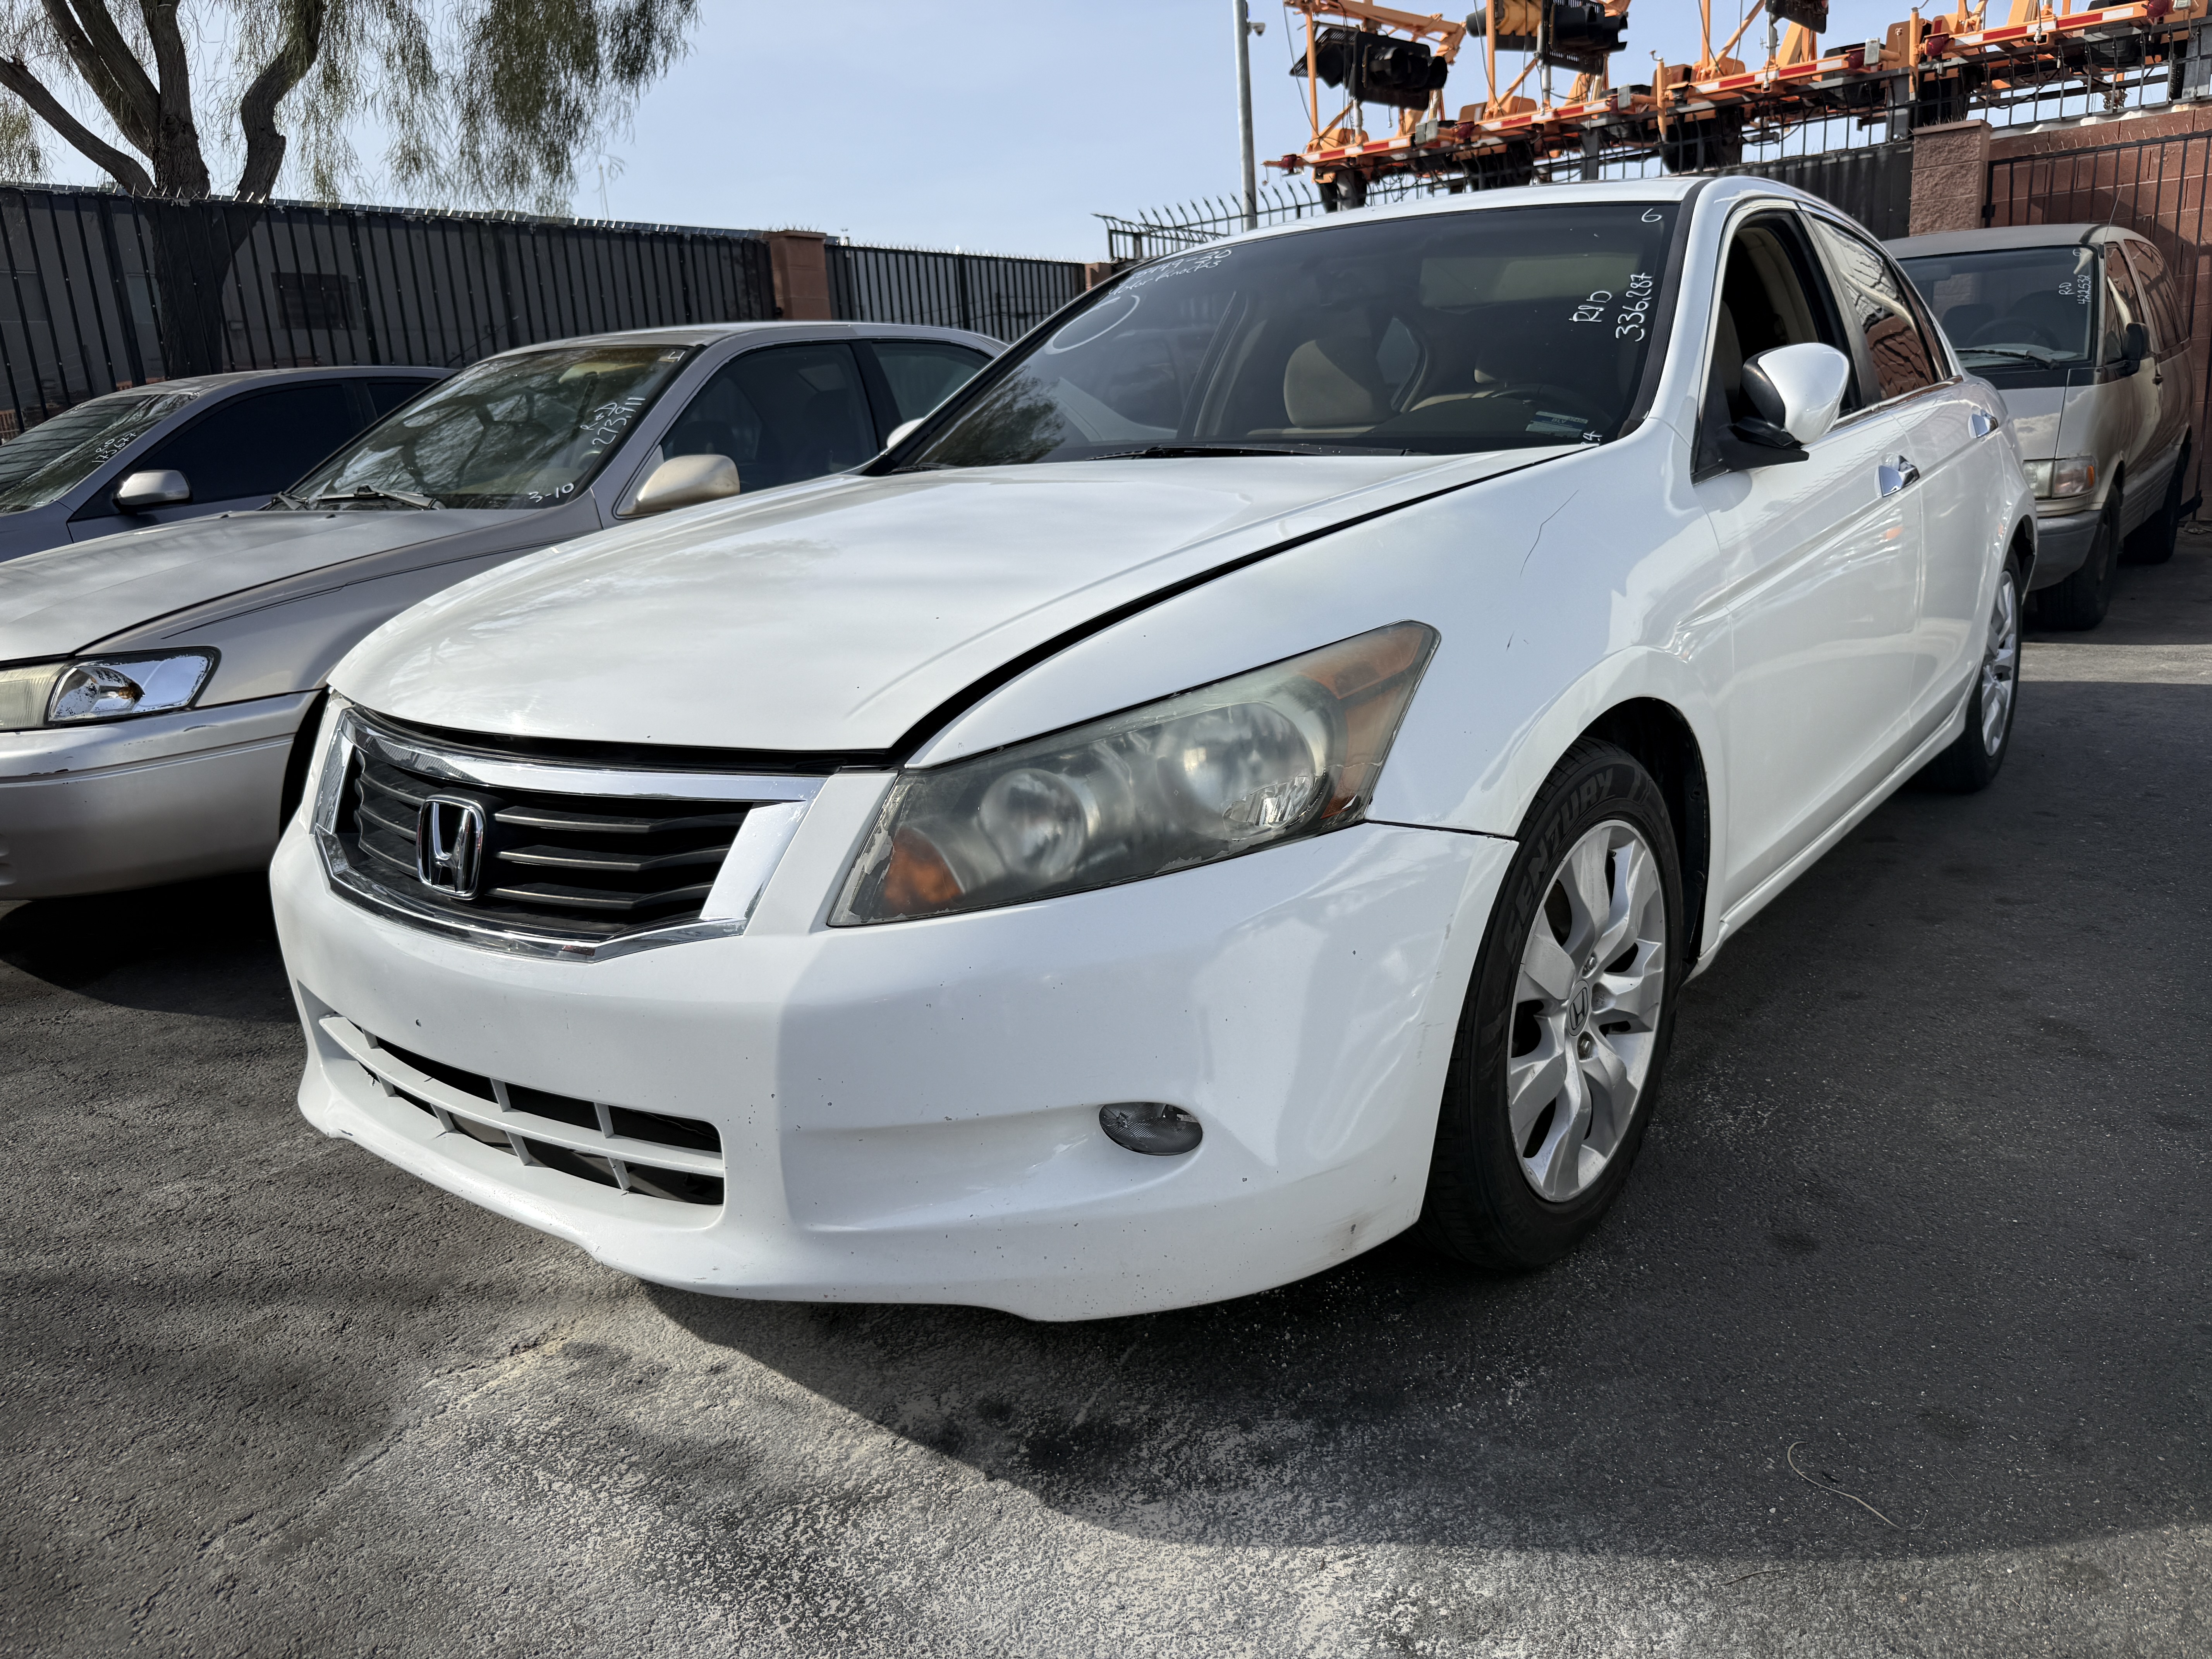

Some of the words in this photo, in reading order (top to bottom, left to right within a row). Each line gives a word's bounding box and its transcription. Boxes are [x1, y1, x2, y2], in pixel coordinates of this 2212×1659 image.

[1615, 272, 1653, 342] 336,287
[667, 350, 686, 362] 4
[592, 397, 646, 445] 273,911
[528, 482, 575, 503] 3-10
